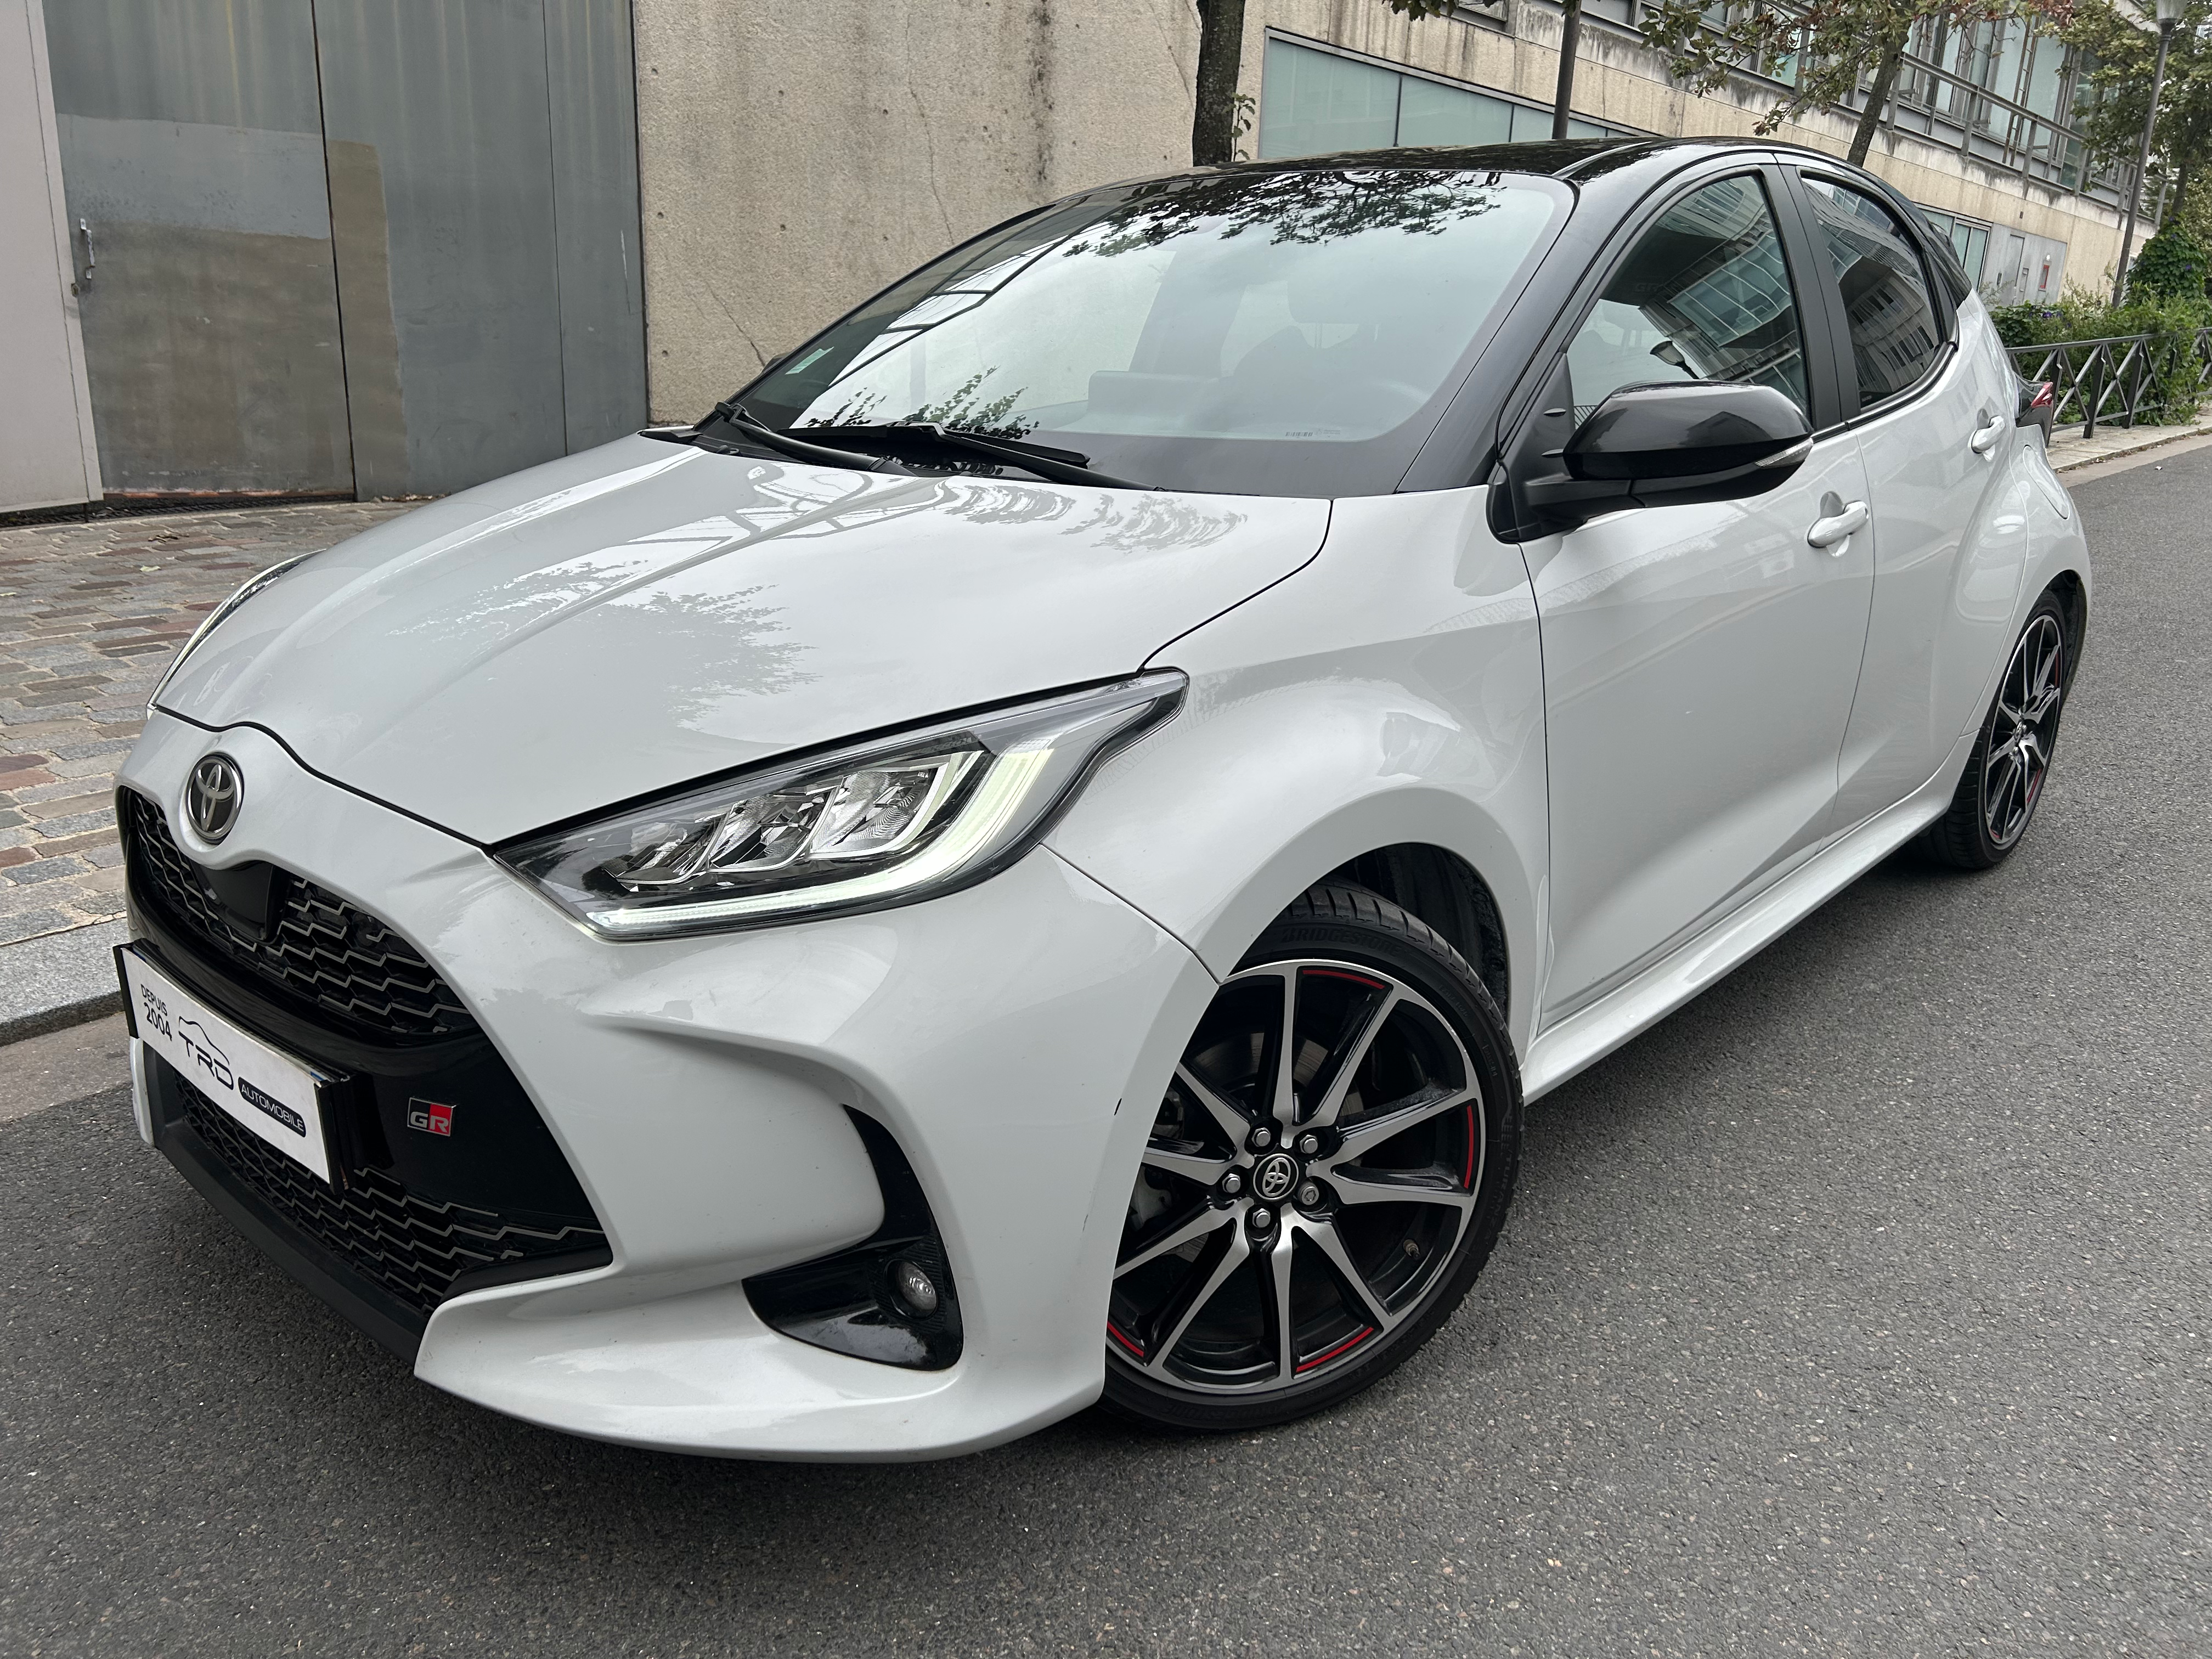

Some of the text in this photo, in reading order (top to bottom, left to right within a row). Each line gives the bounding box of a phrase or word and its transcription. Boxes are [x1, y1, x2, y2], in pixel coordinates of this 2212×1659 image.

[1280, 927, 1403, 958] BRIDGESTONE
[140, 983, 168, 1017] DEPUIS
[144, 1002, 172, 1042] 2004
[178, 1030, 234, 1091] TRD
[241, 1084, 304, 1132] AUTOMOBILE
[410, 1111, 449, 1133] GR
